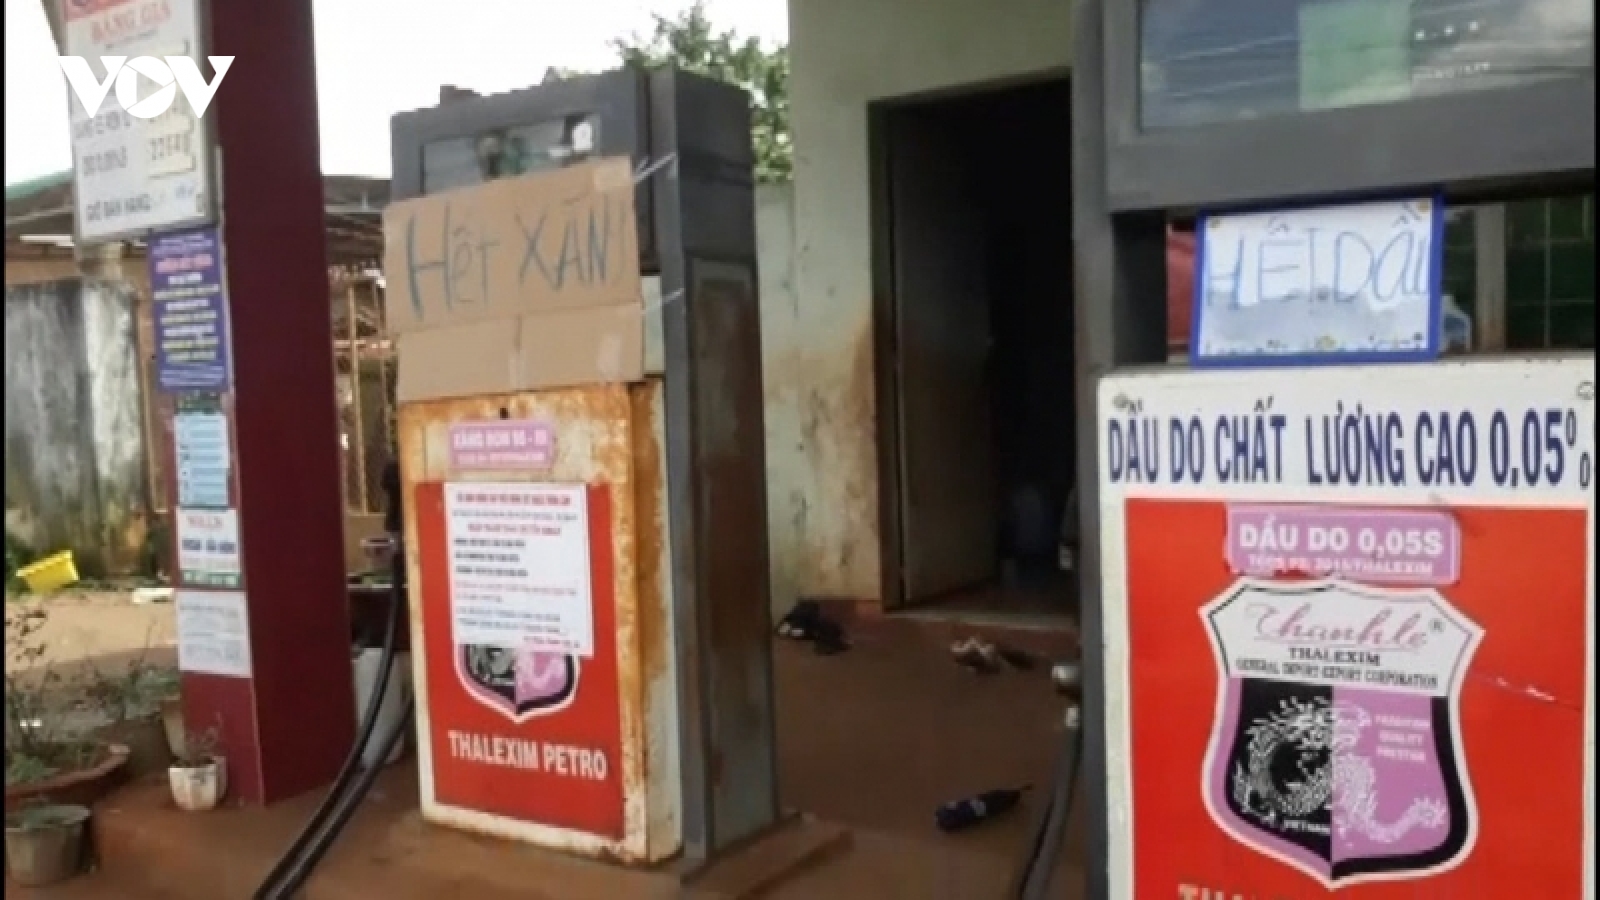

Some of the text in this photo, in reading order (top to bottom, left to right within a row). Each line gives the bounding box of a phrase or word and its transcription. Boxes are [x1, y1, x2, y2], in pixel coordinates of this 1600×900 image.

[1169, 414, 1205, 485] DO
[1214, 395, 1287, 485] CHẤT
[1415, 409, 1478, 486] CAO
[1308, 526, 1349, 552] DO
[1358, 528, 1444, 559] 0,05S
[1288, 647, 1382, 667] THALEXIM
[1366, 669, 1438, 689] CORPORATION
[448, 730, 608, 781] THALEXIM PETRO
